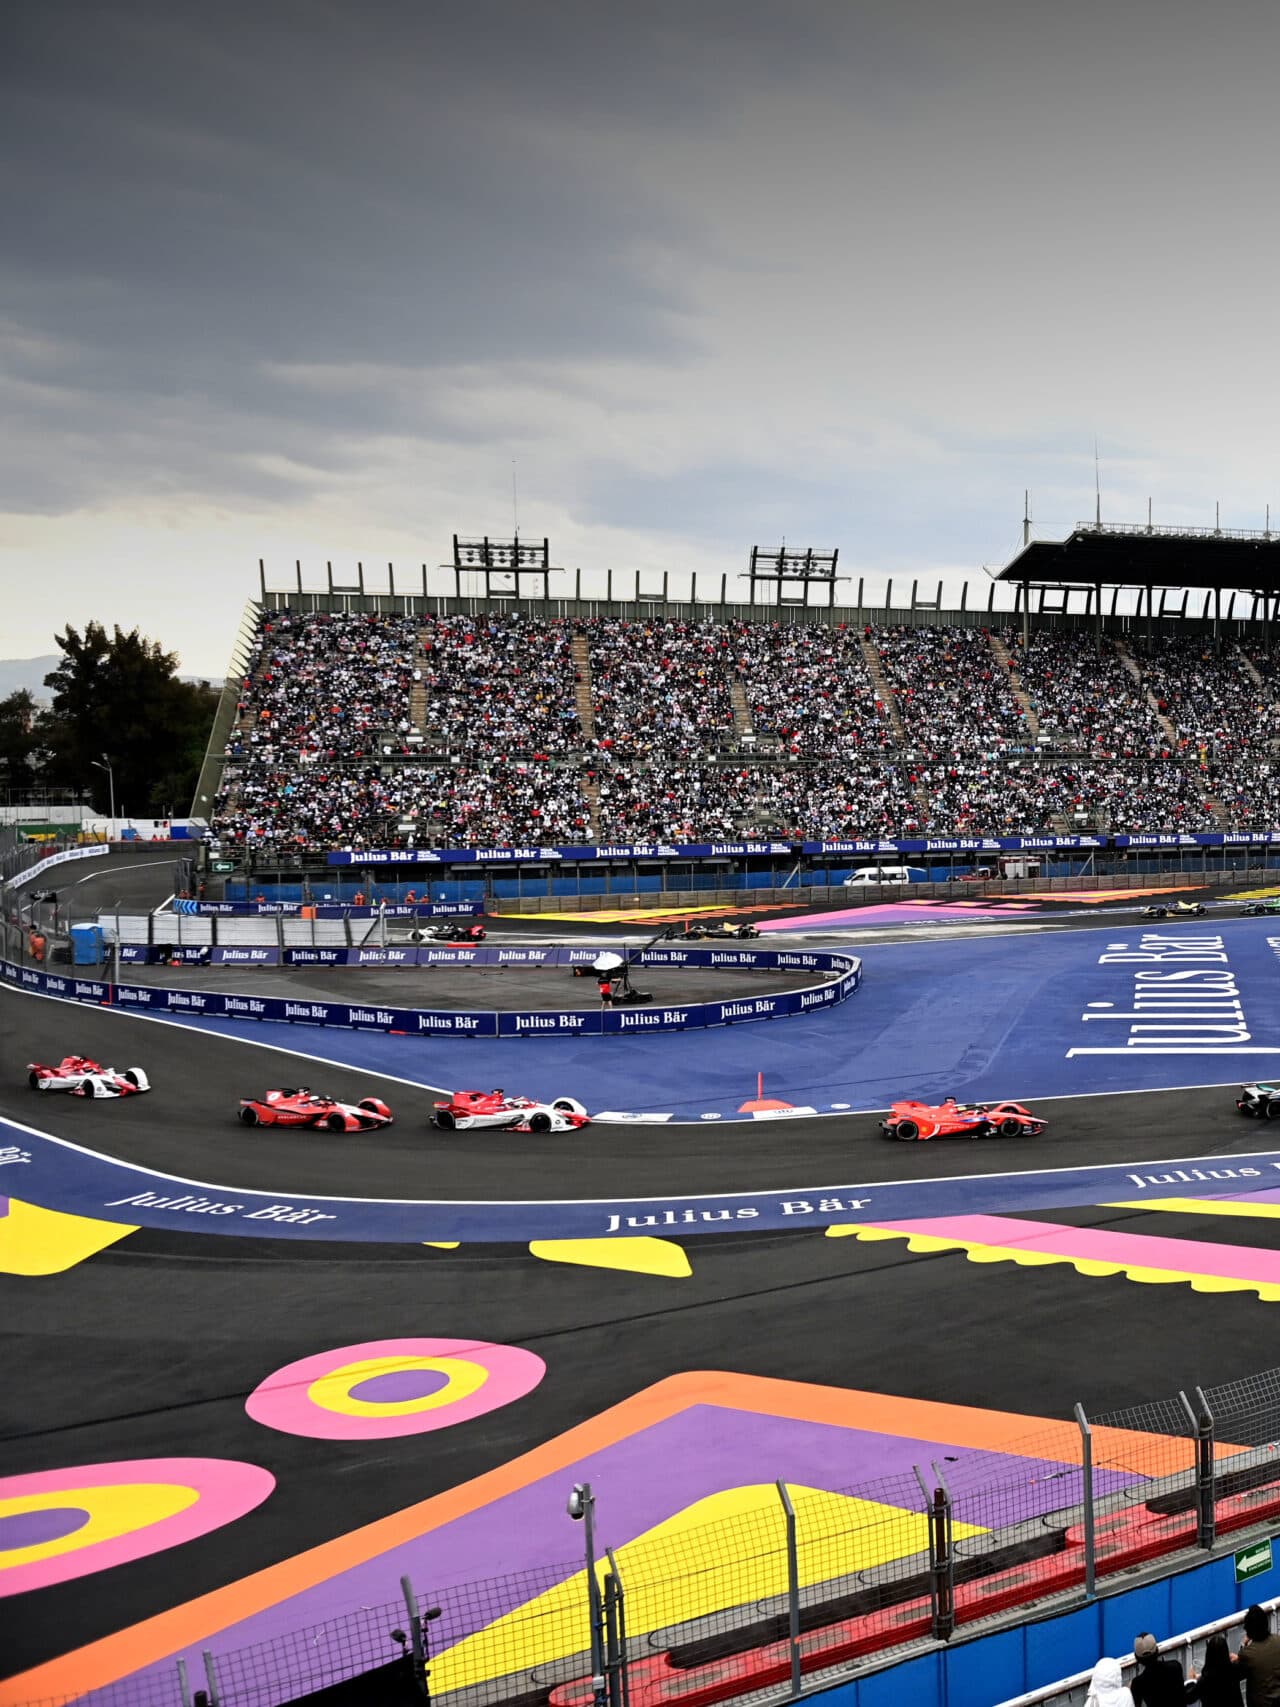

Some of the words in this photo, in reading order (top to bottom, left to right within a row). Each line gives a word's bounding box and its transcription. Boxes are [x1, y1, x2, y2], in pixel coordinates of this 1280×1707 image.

[1020, 838, 1053, 848] Julius
[1056, 837, 1076, 846] Bär
[1129, 835, 1157, 845] Julius
[1159, 835, 1177, 844] Bär
[1224, 834, 1250, 843] Julius
[1251, 833, 1269, 842] Bär
[712, 844, 744, 854] Julius
[747, 844, 767, 853] Bär
[822, 842, 853, 852] Julius
[855, 841, 875, 851] Bär
[927, 840, 957, 850] Julius
[960, 839, 980, 849] Bär
[351, 852, 387, 863] Julius
[391, 851, 414, 861] Bär
[476, 850, 511, 860] Julius
[514, 849, 536, 858] Bär
[596, 847, 629, 857] Julius
[633, 846, 654, 855] Bär
[217, 904, 233, 912] Bär
[281, 903, 298, 911] Bär
[392, 906, 412, 915] Bär
[433, 905, 453, 915] Julius
[455, 904, 473, 913] Bär
[123, 948, 138, 957] Bär
[1098, 934, 1229, 964] Bär
[223, 950, 246, 960] Julius
[249, 950, 268, 959] Bär
[320, 951, 337, 960] Bär
[388, 950, 406, 960] Bär
[428, 951, 455, 961] Julius
[457, 951, 475, 960] Bär
[499, 951, 527, 961] Julius
[529, 951, 546, 960] Bär
[570, 951, 596, 961] Julius
[641, 952, 668, 961] Julius
[670, 952, 688, 961] Bär
[711, 953, 738, 963] Julius
[740, 954, 756, 963] Bär
[778, 954, 801, 965] Julius
[803, 955, 818, 965] Bär
[47, 977, 57, 990] Julius
[58, 980, 66, 991] Bär
[76, 983, 91, 994] Julius
[93, 985, 104, 996] Bär
[118, 988, 137, 1000] Julius
[138, 990, 151, 1002] Bär
[168, 992, 190, 1005] Julius
[191, 994, 206, 1007] Bär
[801, 992, 822, 1008] Julius
[824, 989, 836, 1003] Bär
[224, 998, 249, 1011] Julius
[250, 1001, 265, 1013] Bär
[286, 1003, 310, 1017] Julius
[311, 1006, 328, 1018] Bär
[720, 1004, 752, 1019] Julius
[754, 1001, 776, 1014] Bär
[349, 1009, 375, 1023] Julius
[376, 1012, 394, 1025] Bär
[419, 1015, 451, 1029] Julius
[455, 1017, 479, 1029] Bär
[516, 1015, 556, 1030] Julius
[559, 1015, 584, 1028] Bär
[620, 1013, 660, 1027] Julius
[663, 1011, 687, 1024] Bär
[1125, 1166, 1258, 1189] Julius
[105, 1192, 244, 1217] Julius
[244, 1205, 339, 1226] Bär
[606, 1207, 759, 1232] Julius
[779, 1198, 872, 1216] Bär
